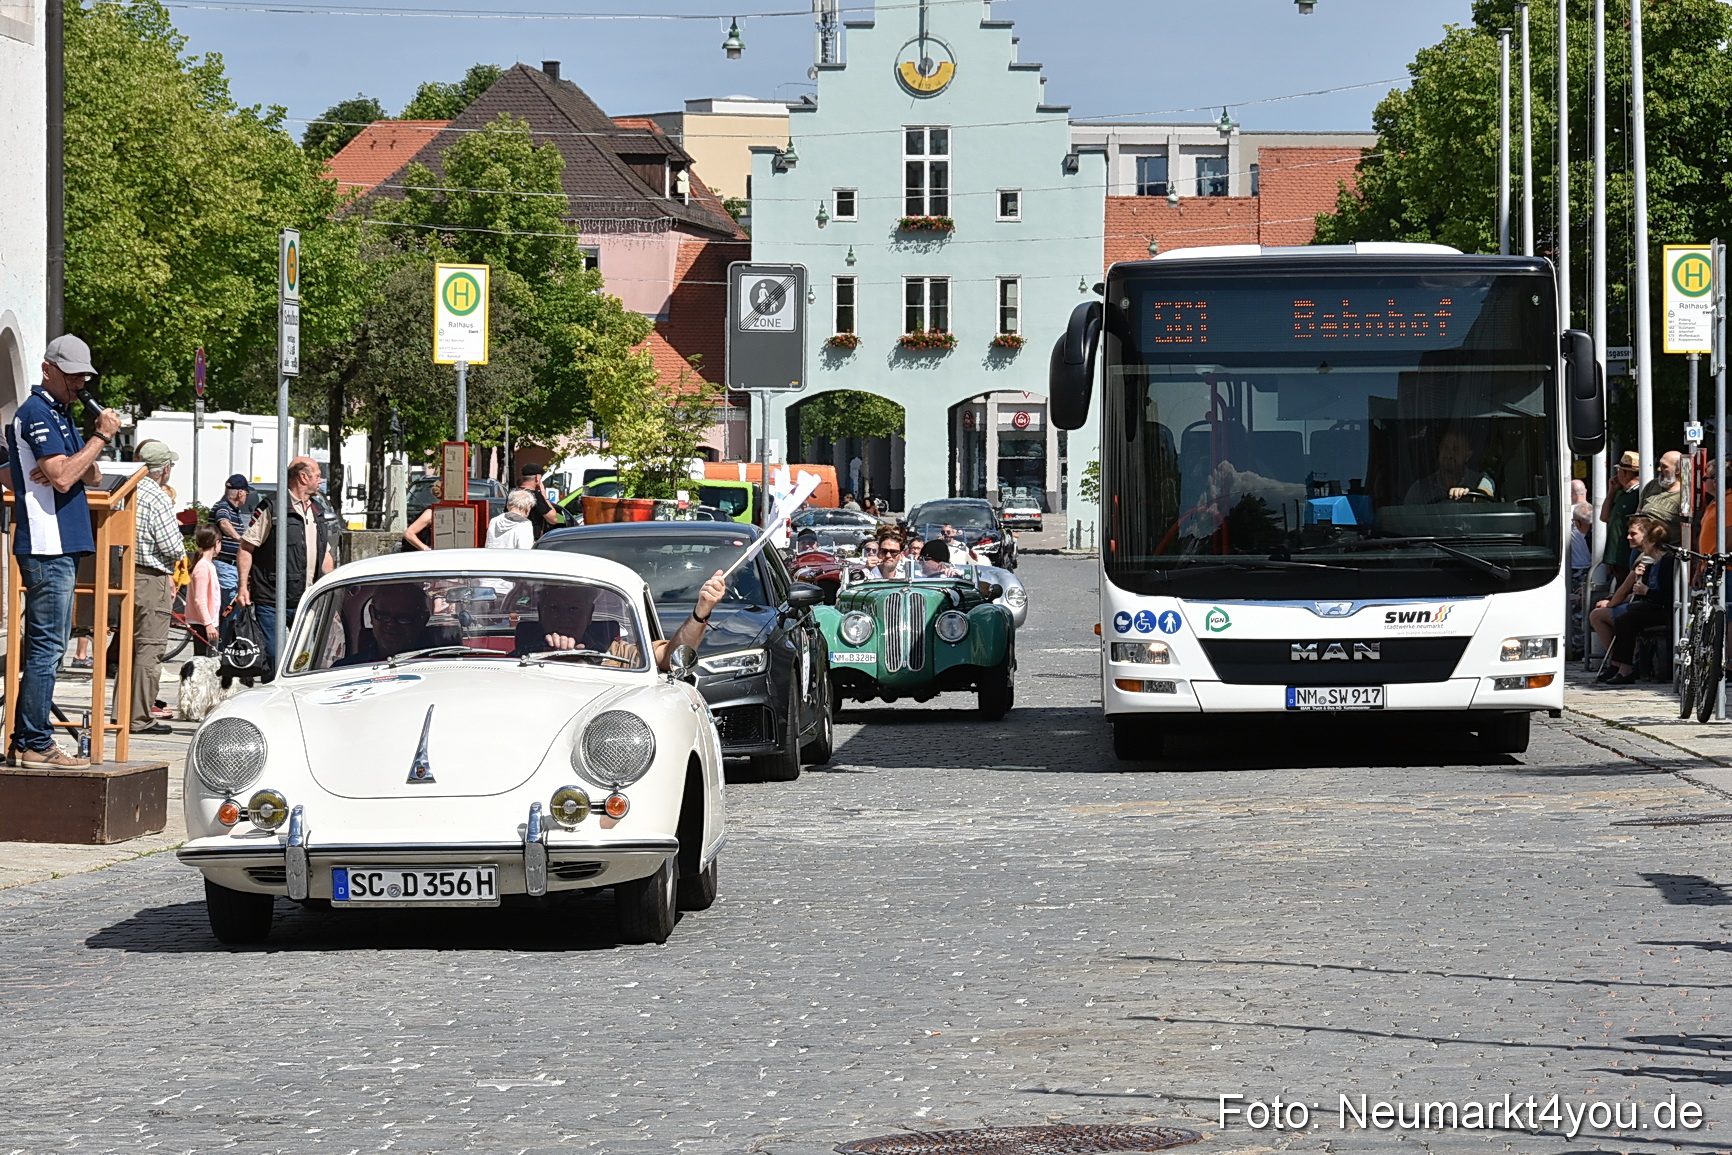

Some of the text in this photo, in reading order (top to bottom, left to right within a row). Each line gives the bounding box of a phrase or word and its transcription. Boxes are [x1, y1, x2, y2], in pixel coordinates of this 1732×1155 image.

[1679, 302, 1709, 310] Rathaus
[754, 318, 782, 328] ZONE
[1294, 298, 1452, 337] Bahnhof
[448, 321, 474, 329] Rathaus
[1384, 610, 1432, 624] swn
[224, 647, 260, 657] NISSAN
[1291, 642, 1381, 661] MAN
[1296, 689, 1317, 704] NM
[1351, 689, 1380, 704] 917
[351, 872, 385, 897] SC
